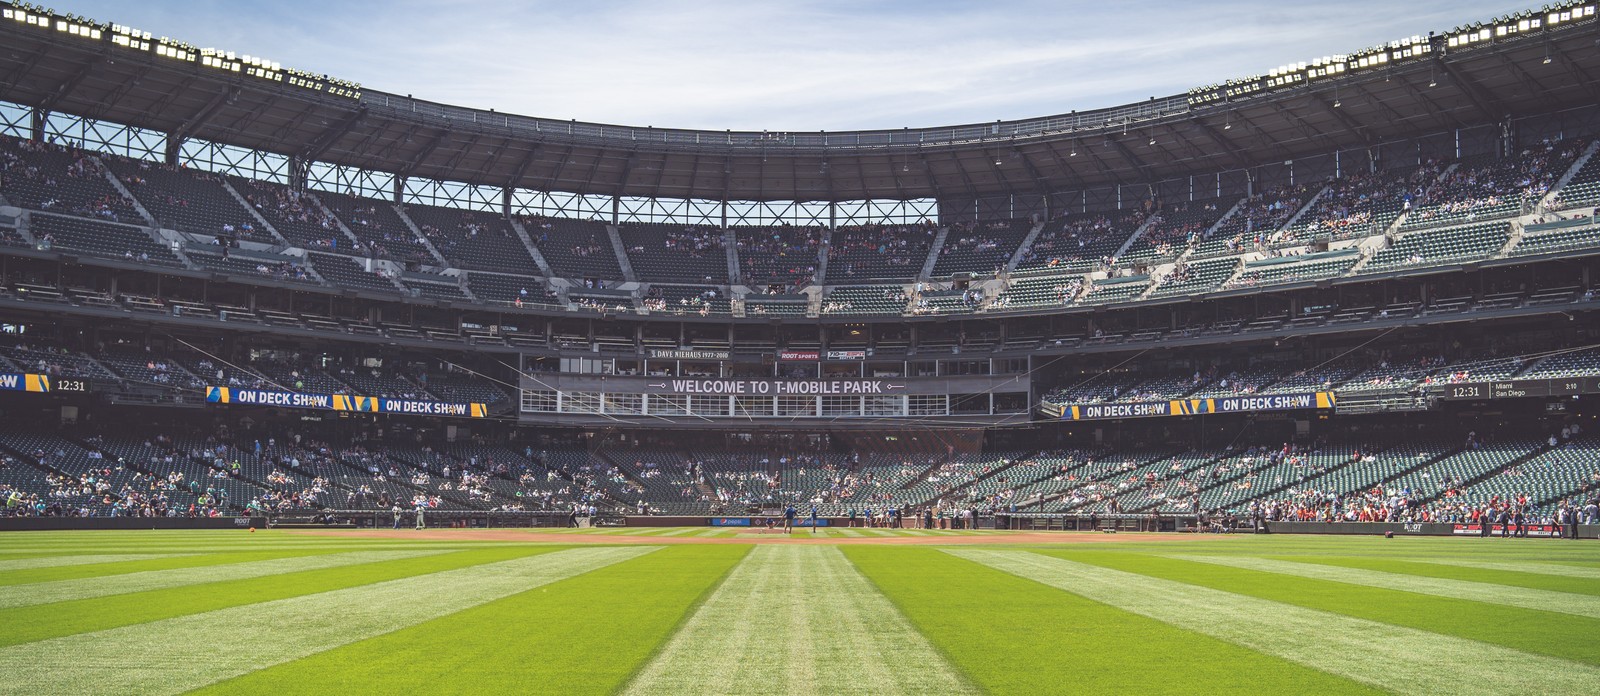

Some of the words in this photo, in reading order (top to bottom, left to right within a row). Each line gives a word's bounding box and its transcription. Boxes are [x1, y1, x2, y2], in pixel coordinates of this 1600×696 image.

[657, 350, 673, 358] DAVE
[675, 350, 701, 358] NIEHAUS
[57, 380, 85, 391] 12:31
[672, 380, 745, 393] WELCOME
[750, 381, 769, 393] TO
[774, 381, 840, 394] T-MOBILE
[844, 381, 882, 393] PARK
[239, 390, 256, 403] ON
[258, 391, 291, 405] DECK
[1453, 387, 1479, 397] 12:31
[386, 400, 401, 412] ON
[403, 401, 432, 414] DECK
[1223, 399, 1239, 410] ON
[1241, 397, 1272, 409] DECK
[1087, 406, 1101, 417] ON
[1104, 405, 1132, 416] DECK
